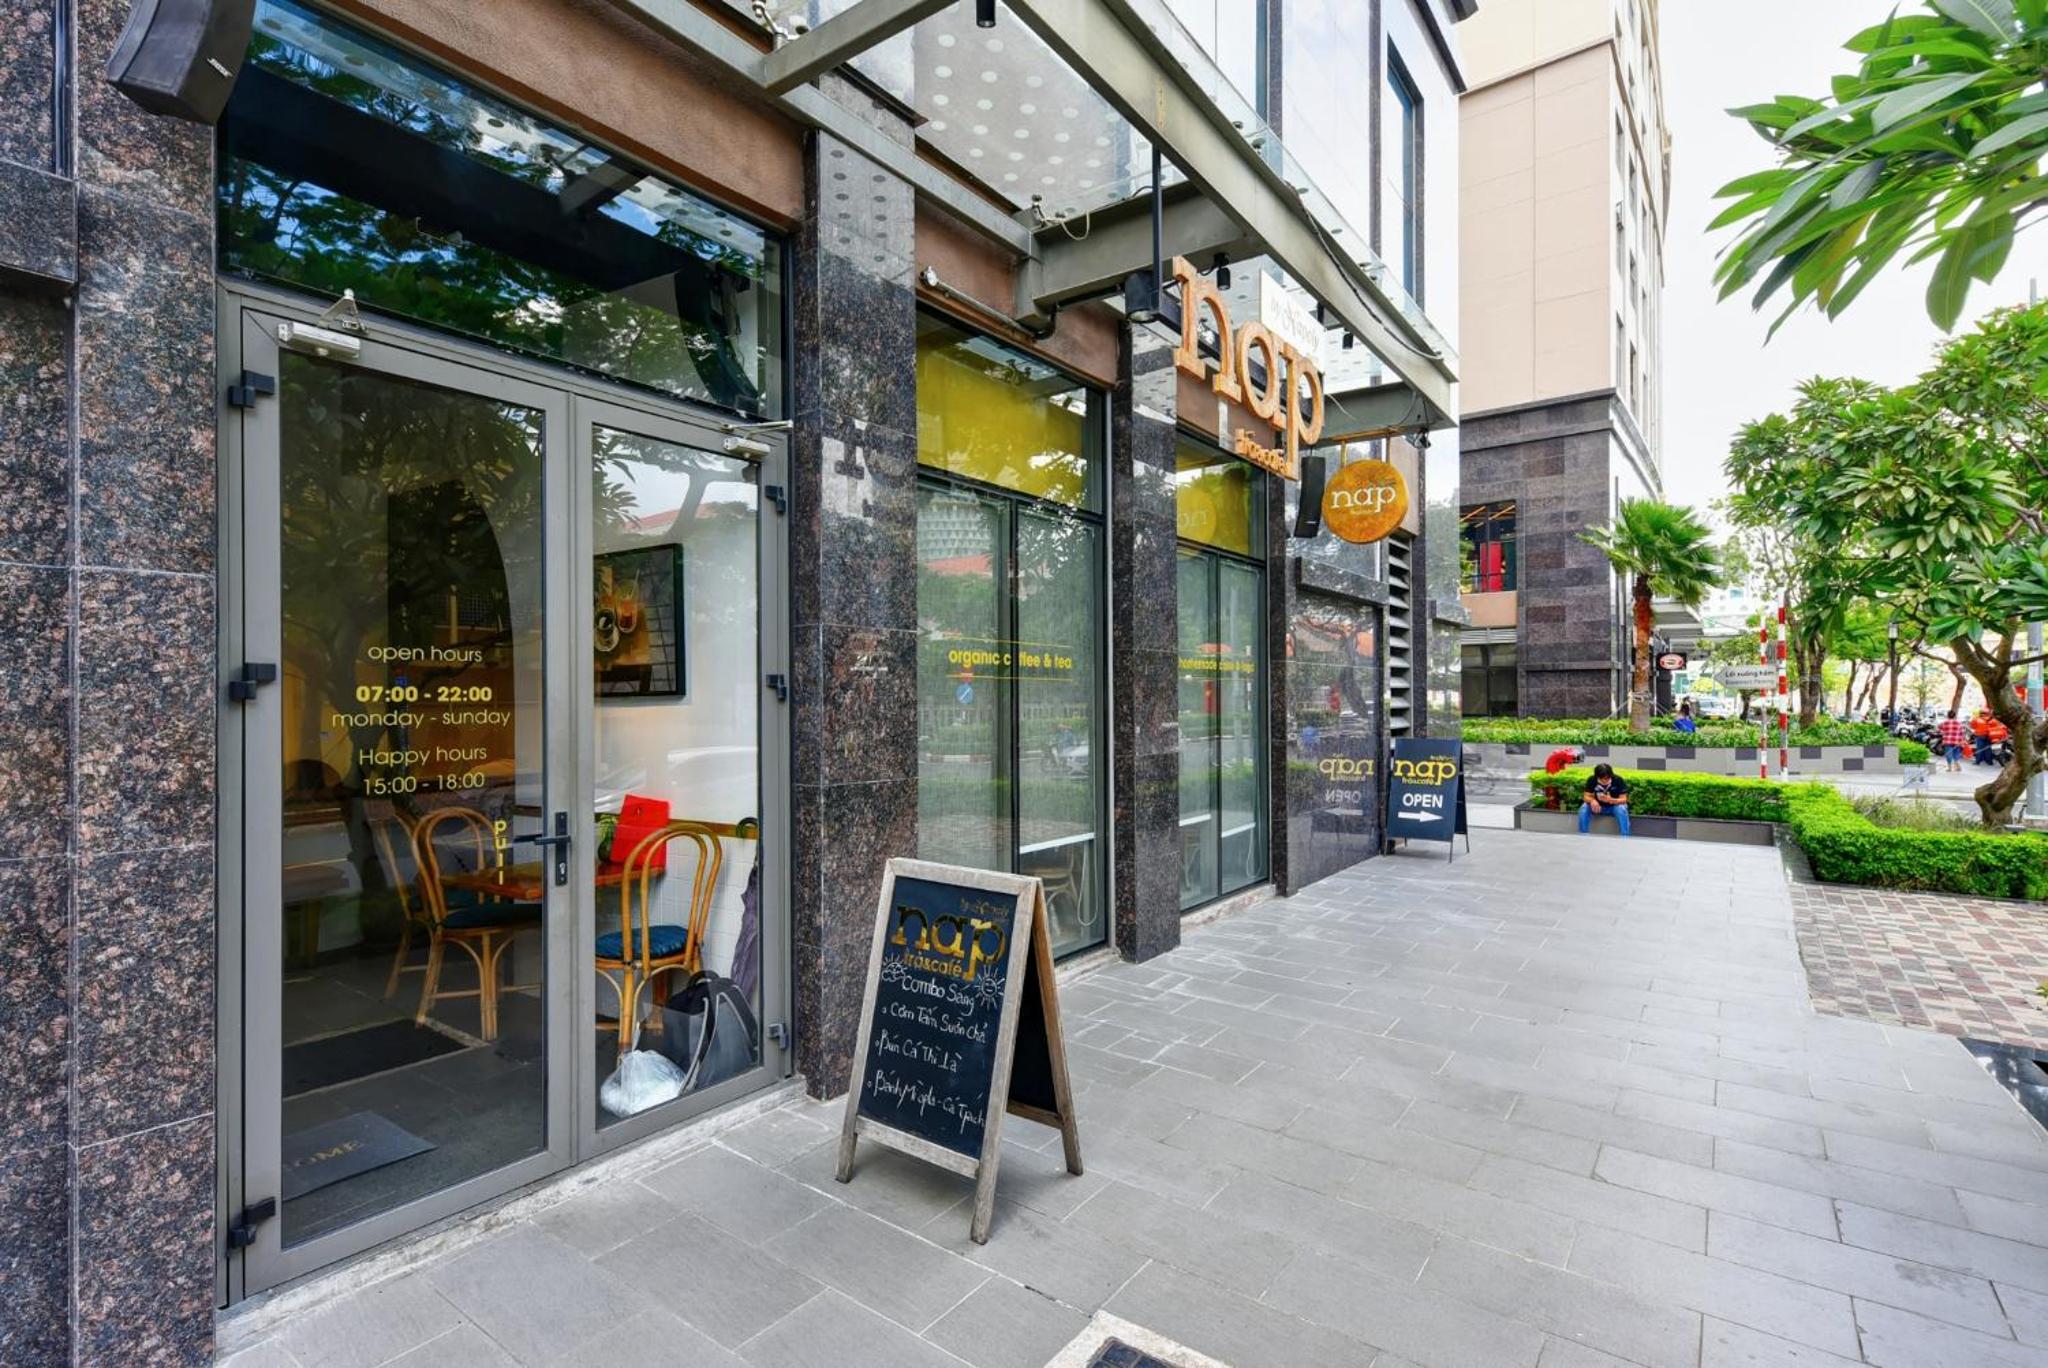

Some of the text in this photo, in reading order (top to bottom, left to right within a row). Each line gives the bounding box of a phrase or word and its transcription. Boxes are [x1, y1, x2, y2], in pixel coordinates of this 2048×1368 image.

[1173, 255, 1325, 481] nap
[1330, 485, 1396, 513] nap
[367, 645, 483, 664] open hours
[948, 650, 1000, 668] organic
[1054, 654, 1072, 669] tea
[356, 685, 419, 702] 07:00
[437, 686, 493, 702] 22:00
[332, 710, 425, 728] monday
[442, 708, 511, 728] sunday
[358, 746, 488, 767] Happy hours
[363, 776, 417, 795] 15:00
[437, 772, 485, 791] 18:00
[1394, 759, 1457, 786] nap
[1402, 792, 1443, 809] OPEN
[495, 819, 507, 886] pull
[891, 904, 1005, 982] nap
[901, 975, 945, 998] Combo
[902, 1039, 923, 1059] Cá
